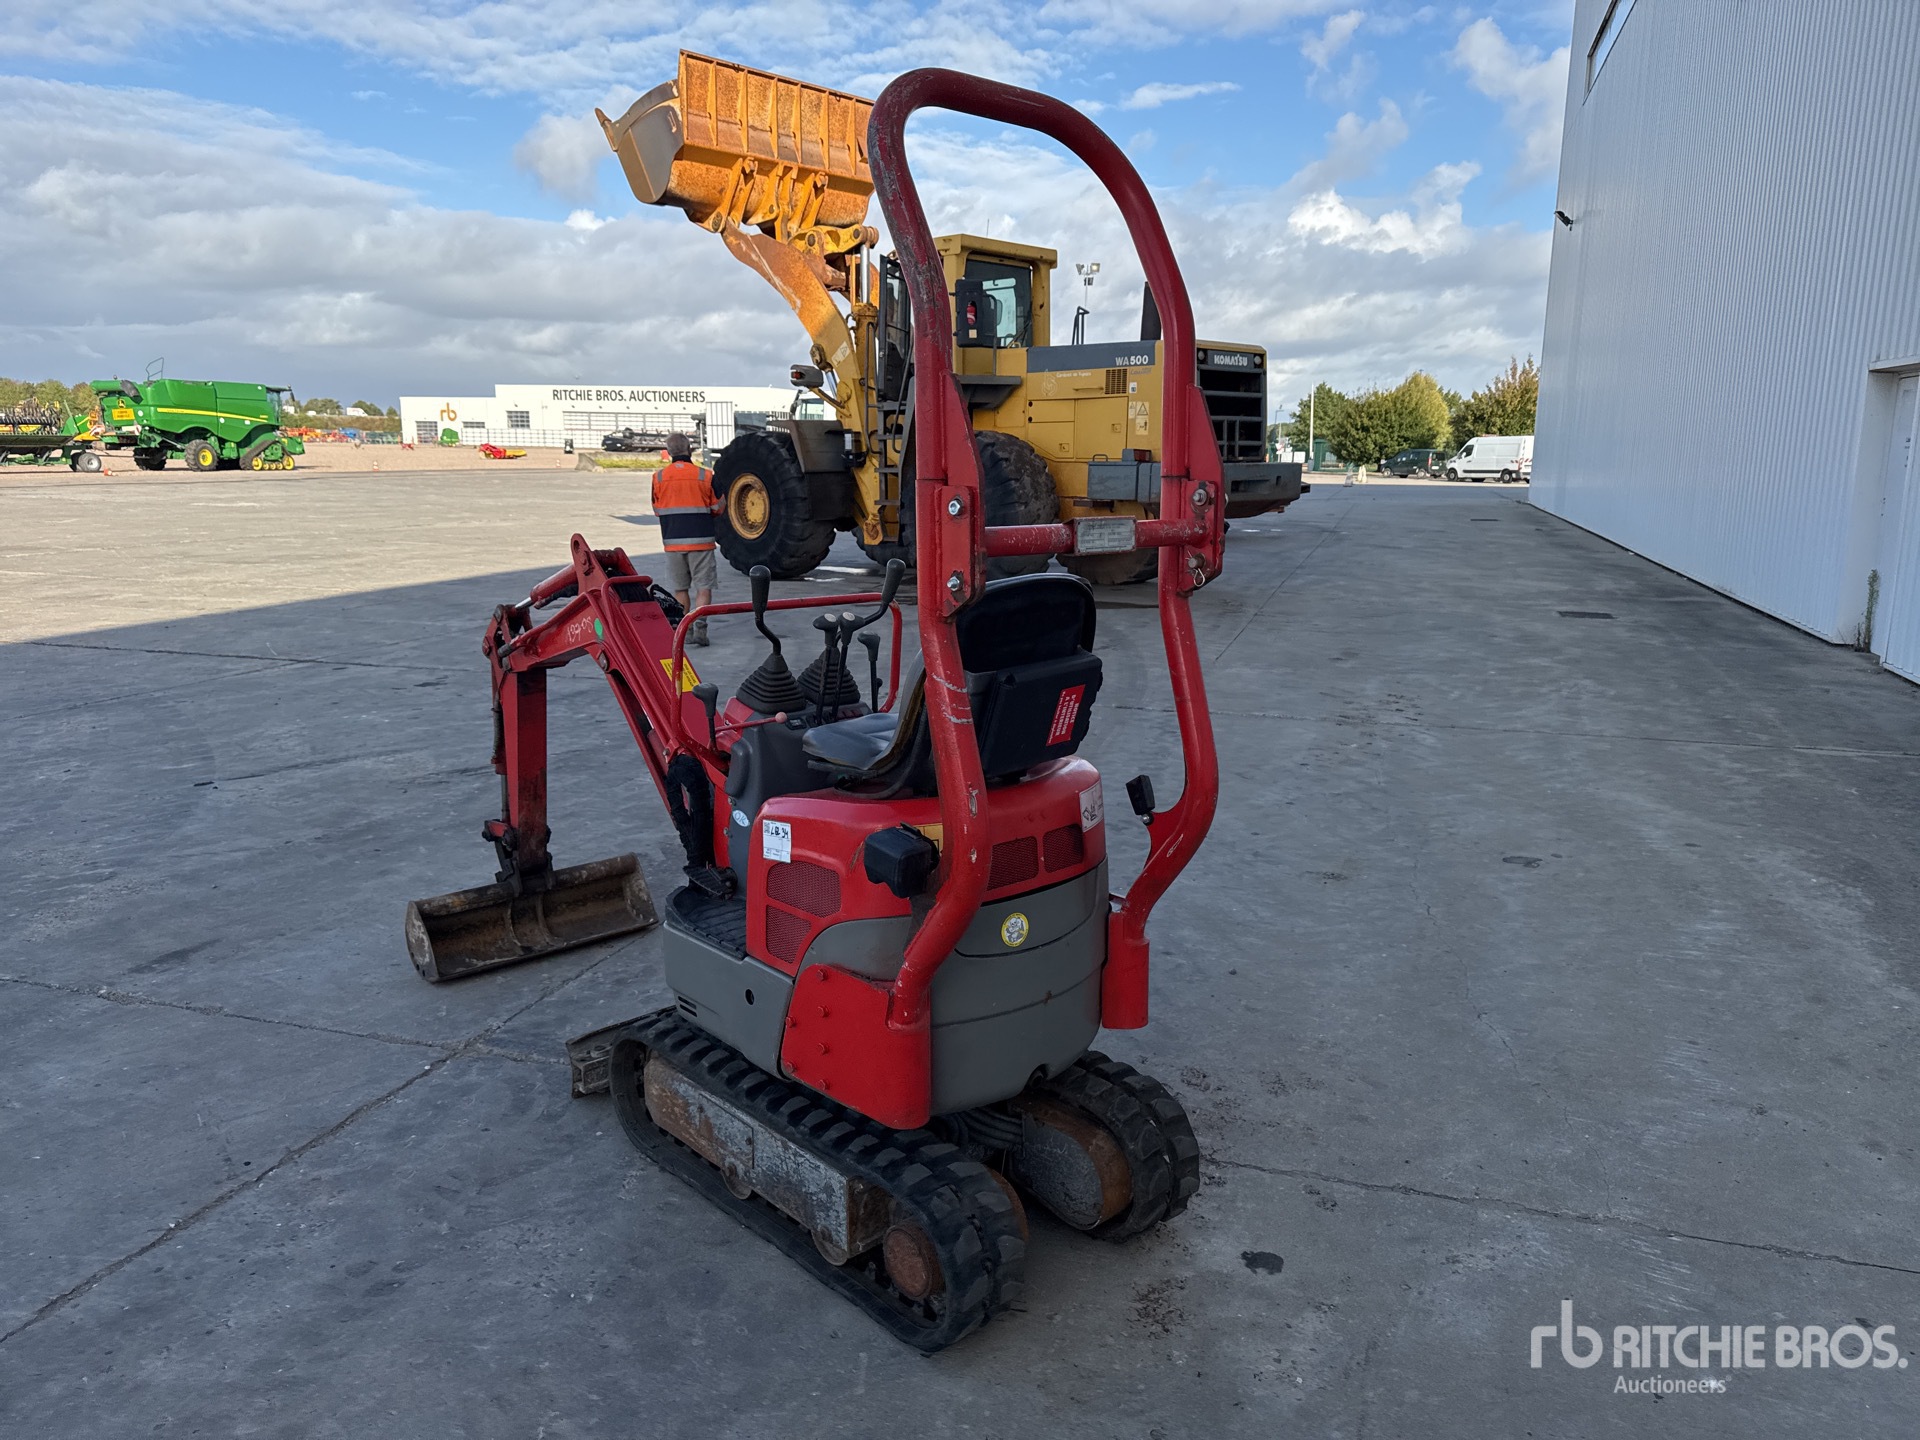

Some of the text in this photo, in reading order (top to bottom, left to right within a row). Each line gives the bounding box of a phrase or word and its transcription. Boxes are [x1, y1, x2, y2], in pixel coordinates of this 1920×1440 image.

[1115, 355, 1149, 366] WA500
[1213, 353, 1248, 366] KOMATSU
[552, 389, 706, 403] RITCHIE BROS. AUCTIONEERS
[440, 403, 457, 421] rb
